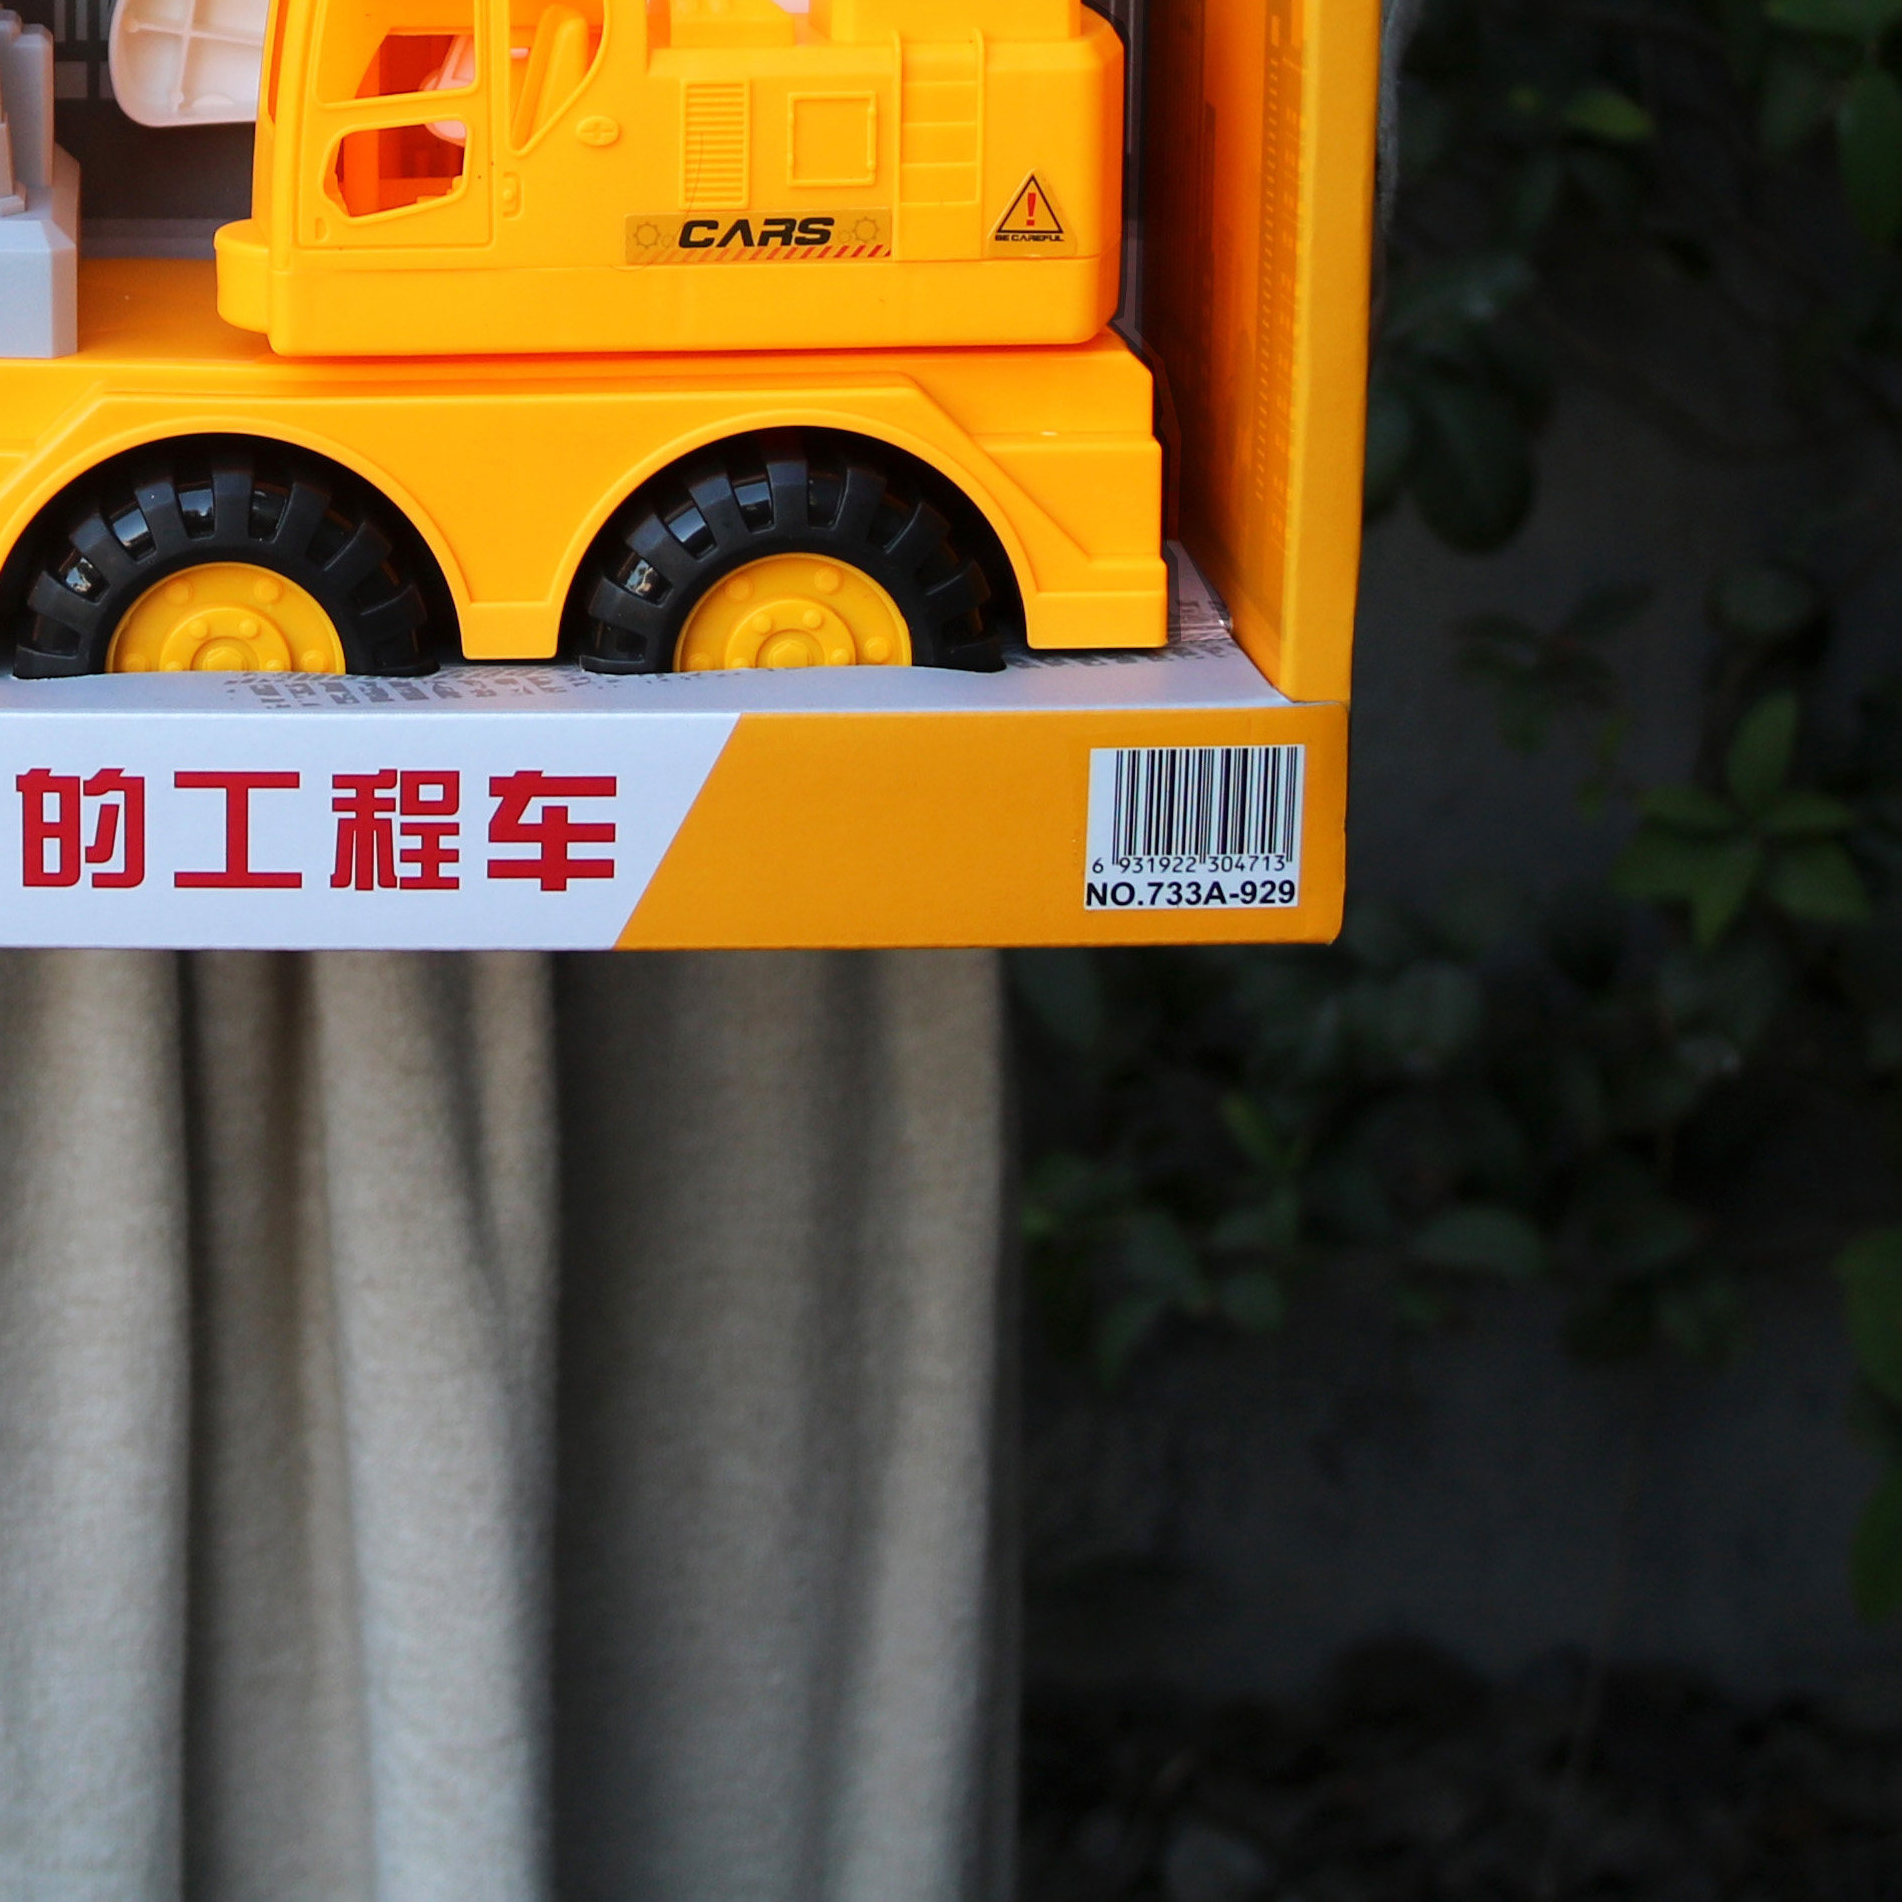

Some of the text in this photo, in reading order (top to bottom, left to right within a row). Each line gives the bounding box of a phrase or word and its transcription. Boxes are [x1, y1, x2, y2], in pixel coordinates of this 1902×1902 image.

[678, 216, 835, 248] CARS
[1092, 854, 1286, 874] 6 931922 304713
[1085, 879, 1296, 907] NO.733A-929
